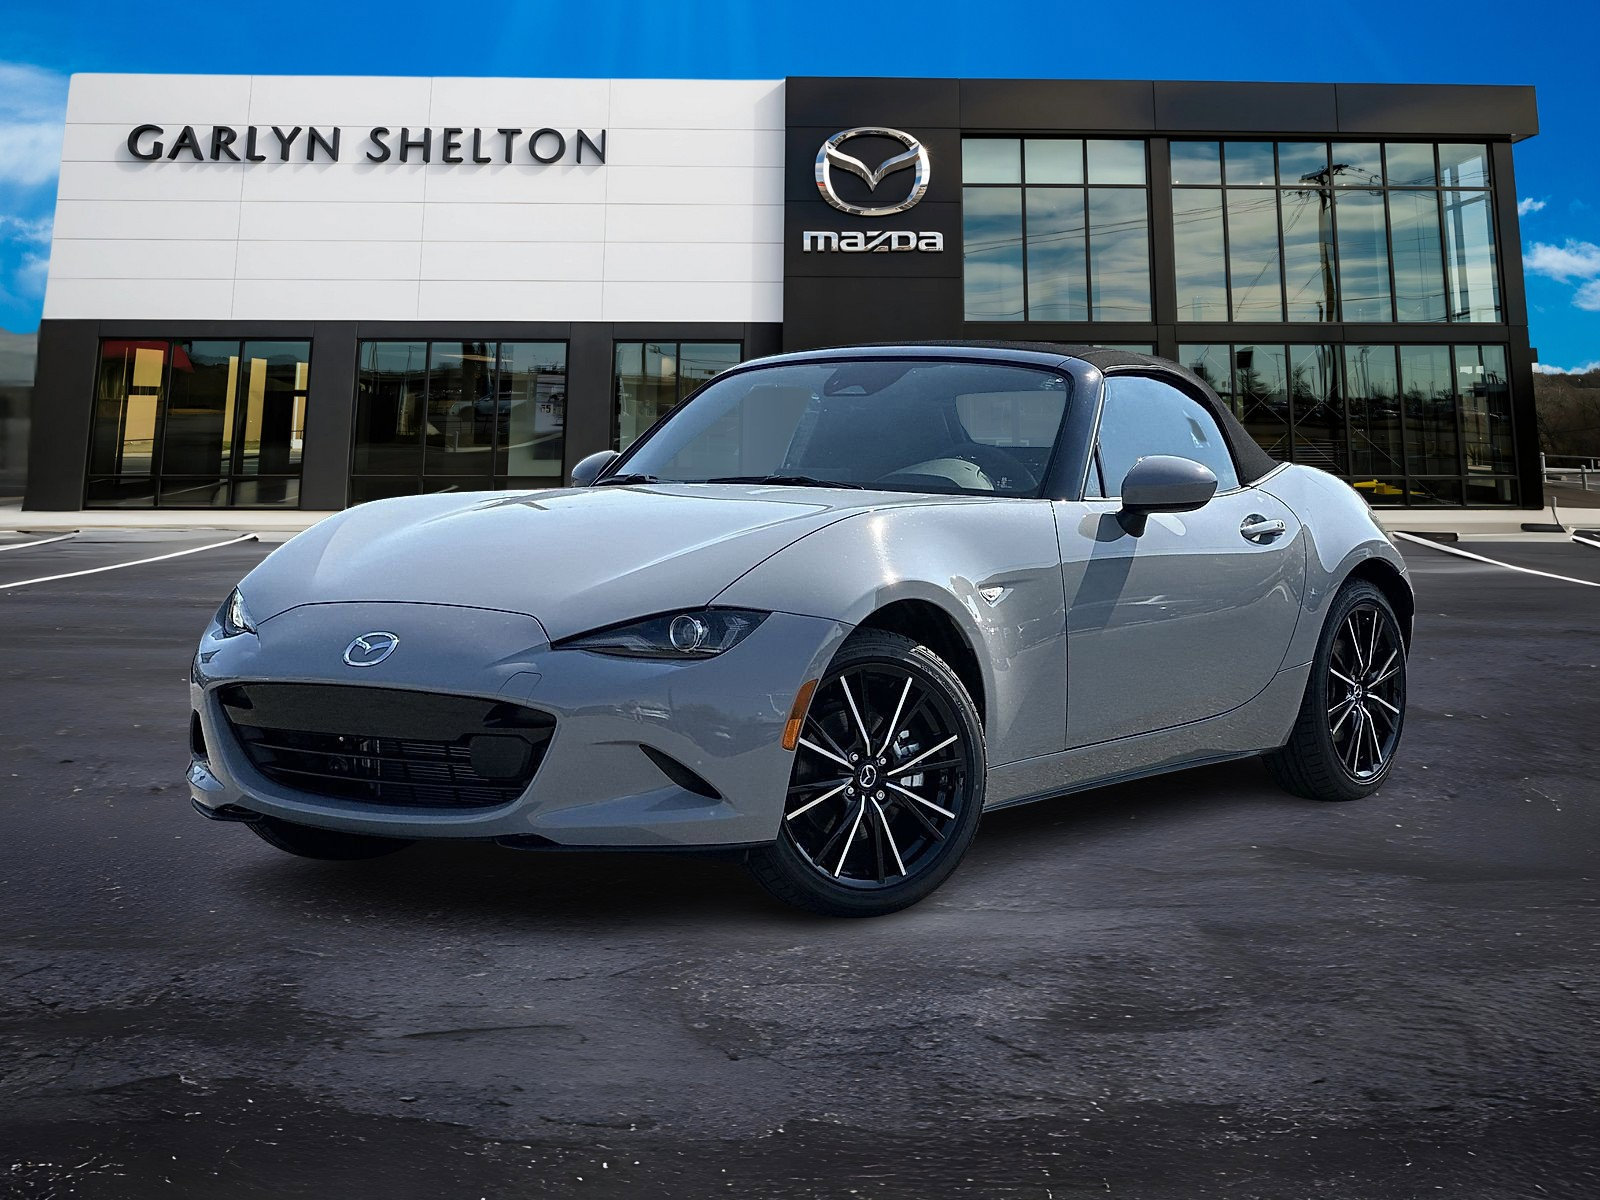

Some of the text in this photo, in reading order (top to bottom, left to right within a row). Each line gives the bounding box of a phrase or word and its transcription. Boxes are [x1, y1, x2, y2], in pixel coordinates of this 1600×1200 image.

[127, 124, 606, 164] GARLYN SHELTON
[803, 230, 944, 252] mazda
